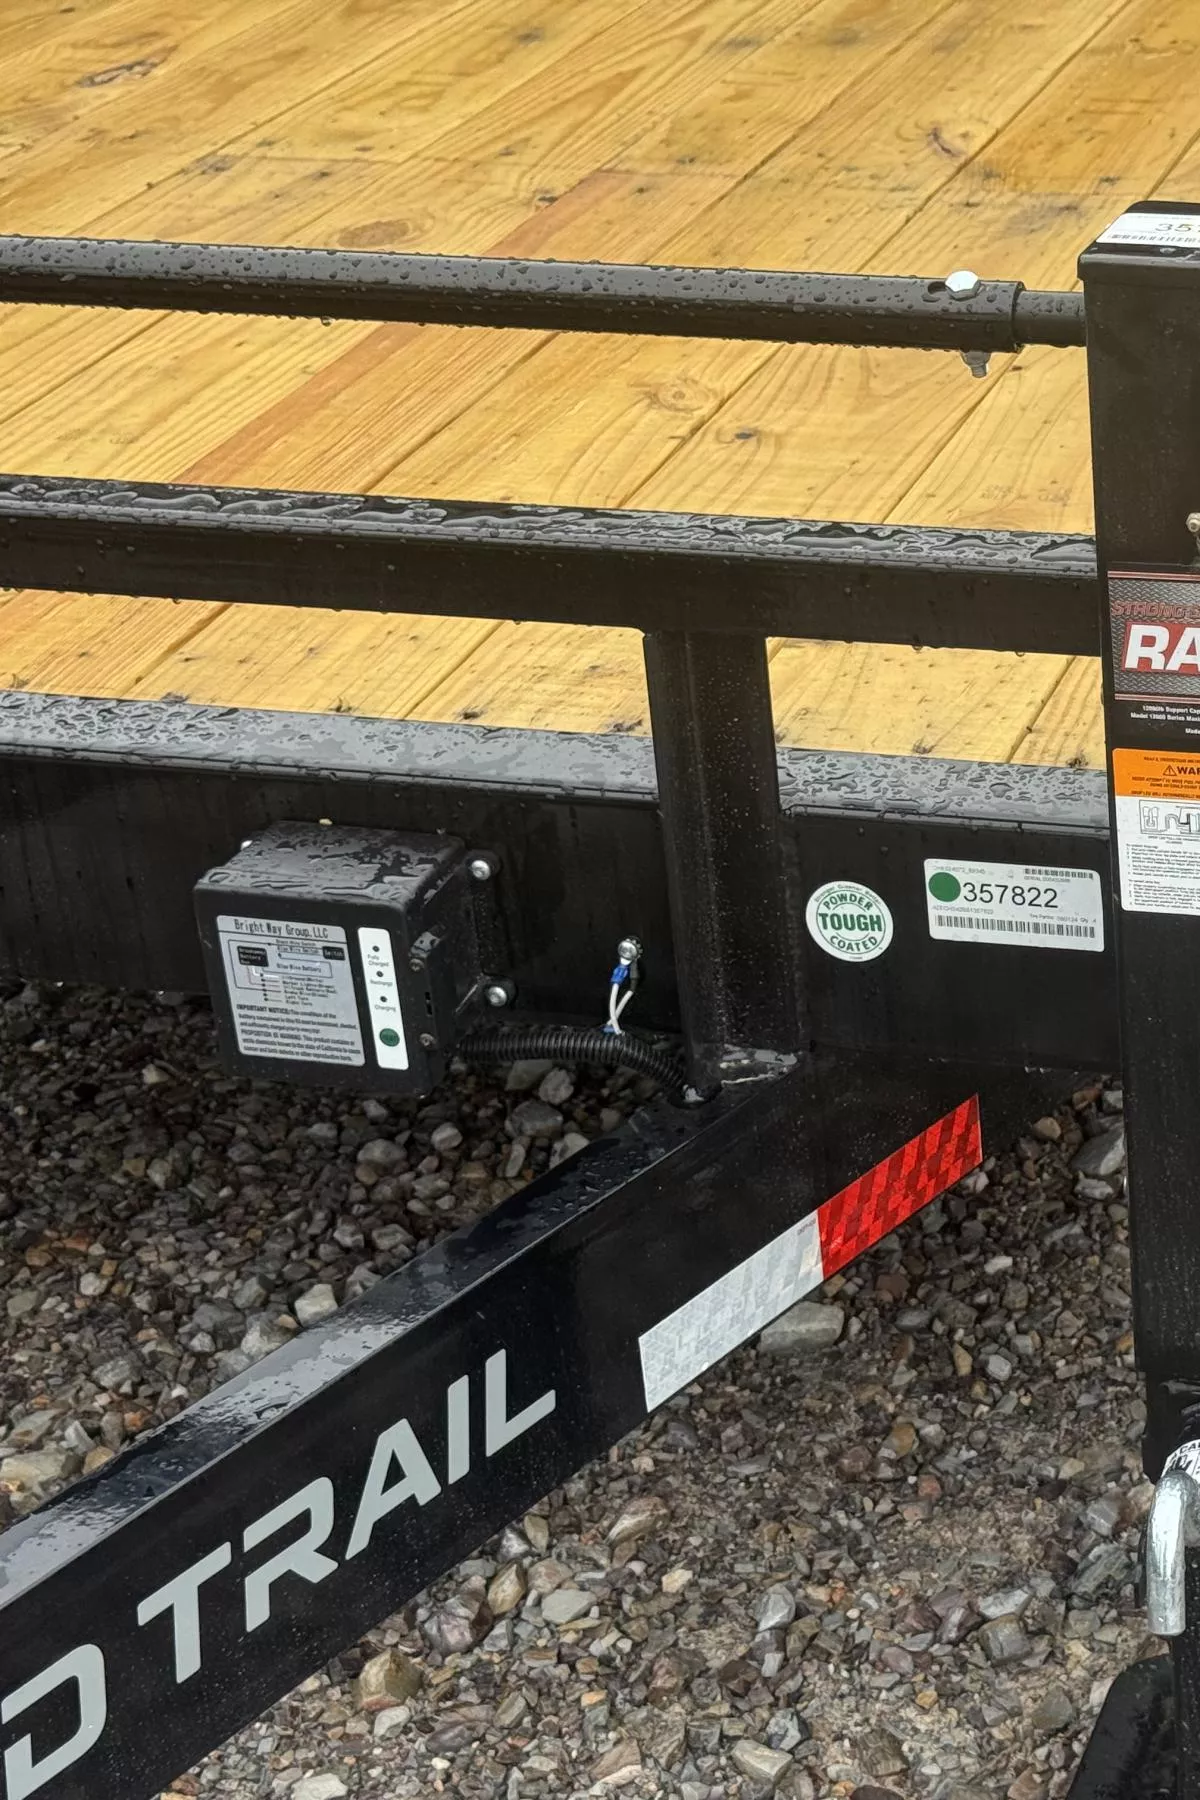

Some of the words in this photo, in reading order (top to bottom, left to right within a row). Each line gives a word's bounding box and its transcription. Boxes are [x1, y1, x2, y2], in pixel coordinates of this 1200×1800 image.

[823, 893, 873, 910] POWDER
[963, 882, 1058, 908] 357822
[234, 919, 264, 935] Bright
[266, 922, 282, 936] Way
[818, 912, 882, 932] TOUGH
[830, 935, 877, 952] COATED
[137, 1348, 556, 1684] TRAIL
